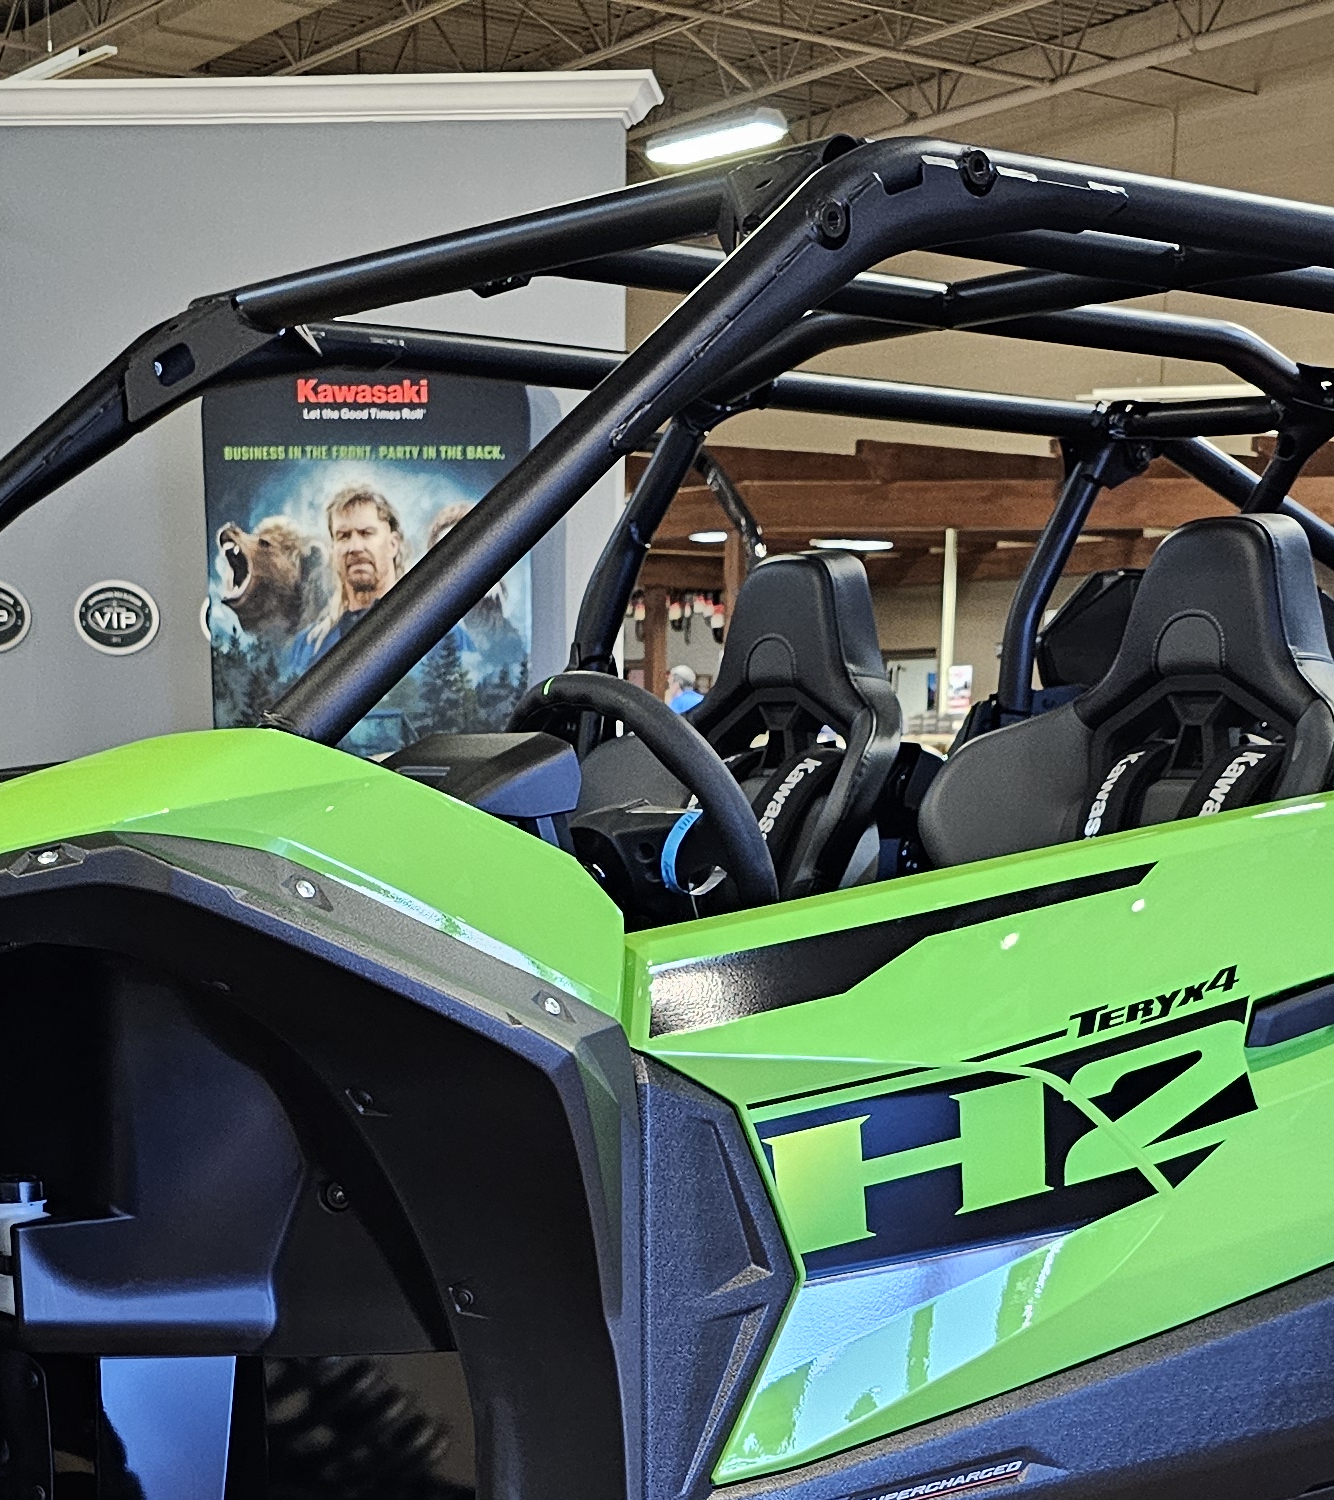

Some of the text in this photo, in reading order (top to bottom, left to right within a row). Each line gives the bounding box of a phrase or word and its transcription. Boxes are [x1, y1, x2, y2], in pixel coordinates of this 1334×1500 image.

[297, 378, 428, 404] Kawasaki
[303, 407, 321, 420] Let
[322, 408, 340, 420] the
[340, 407, 369, 420] Good
[370, 407, 401, 420] Times
[224, 445, 286, 461] BUSINESS
[288, 445, 302, 460] IN
[305, 445, 327, 460] THE
[379, 445, 420, 460] PARTY
[422, 445, 436, 460] IN
[439, 445, 465, 460] THE
[94, 611, 136, 629] VIP
[758, 757, 822, 840] Kawas
[1084, 751, 1146, 838] Kawas
[761, 1018, 1249, 1255] H2
